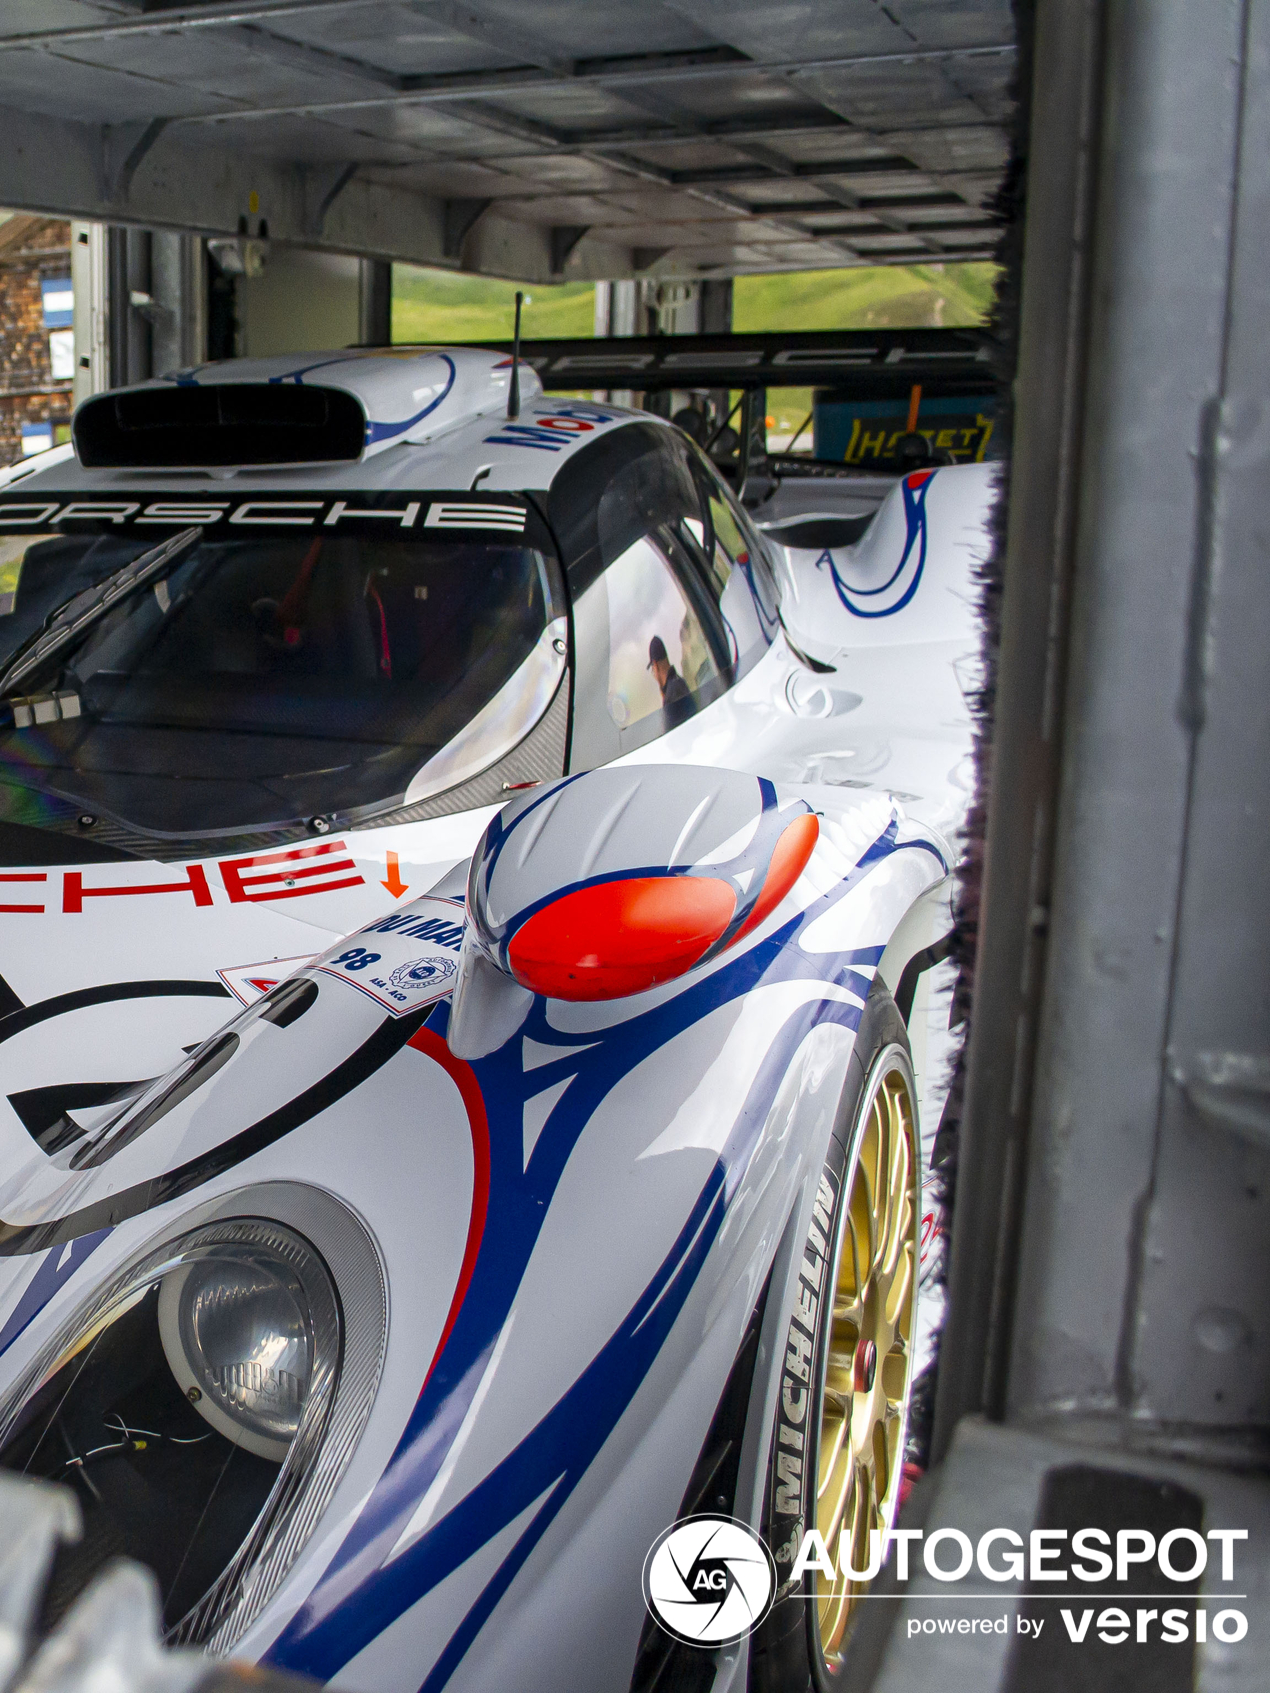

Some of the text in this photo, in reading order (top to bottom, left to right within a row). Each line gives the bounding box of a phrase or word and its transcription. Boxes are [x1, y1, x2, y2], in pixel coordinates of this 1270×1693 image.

[329, 947, 382, 971] 98
[388, 989, 407, 1002] ACO
[774, 1172, 835, 1515] MICHELIN
